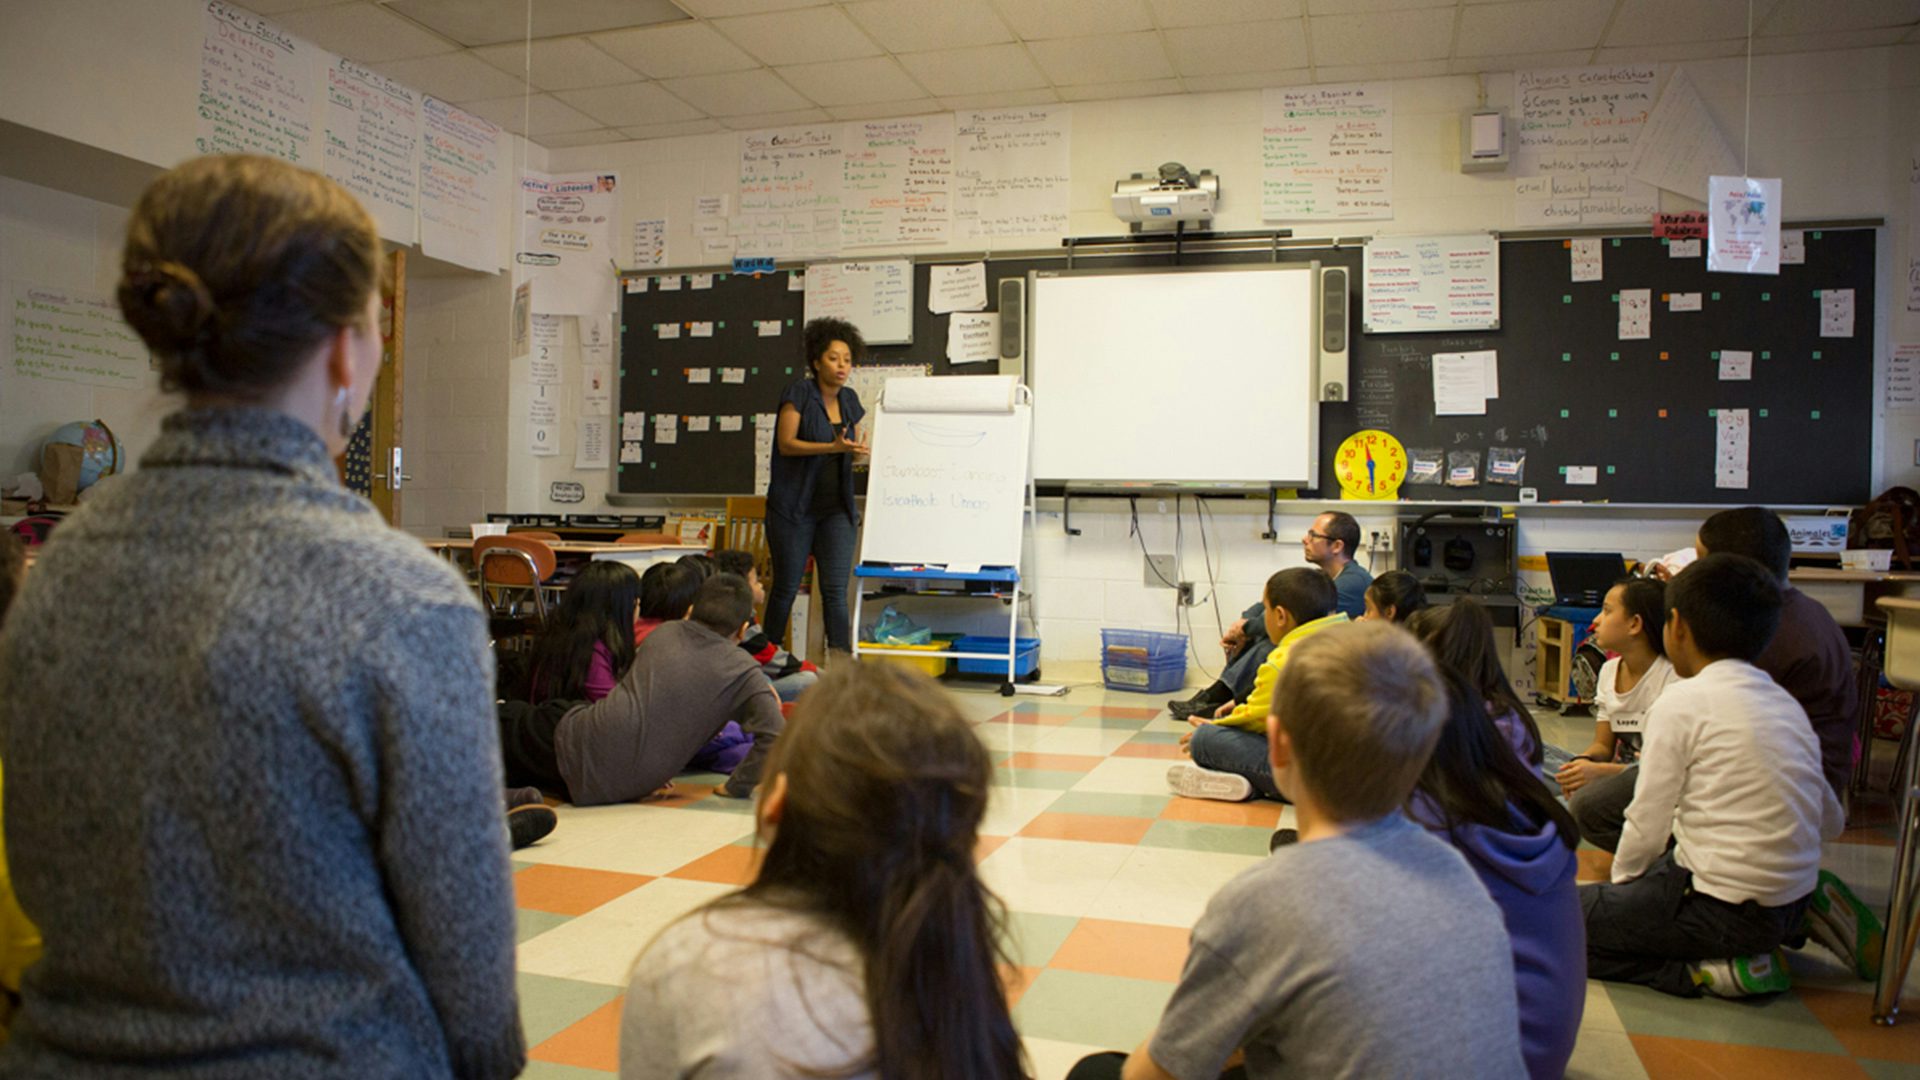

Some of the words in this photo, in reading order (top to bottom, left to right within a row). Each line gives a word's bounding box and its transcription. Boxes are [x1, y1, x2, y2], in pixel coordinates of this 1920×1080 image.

[1624, 92, 1648, 100] una
[522, 180, 549, 190] Active
[556, 184, 594, 193] Listening
[1516, 180, 1546, 194] cruel
[1660, 214, 1696, 224] Muralla
[1664, 225, 1702, 235] Palabras
[735, 258, 756, 267] Word
[540, 348, 548, 360] 2
[540, 386, 546, 397] 1
[537, 430, 546, 442] 0
[1366, 435, 1377, 444] 12
[1354, 440, 1364, 448] 11
[1382, 439, 1387, 448] 1
[1345, 449, 1356, 458] 10
[1390, 448, 1398, 456] 2
[1342, 460, 1348, 469] 9
[1394, 460, 1401, 470] 3
[1346, 472, 1352, 481] 8
[1389, 472, 1396, 481] 4
[1355, 480, 1362, 490] 7
[1367, 482, 1374, 493] 6
[1379, 480, 1386, 490] 5
[1790, 528, 1831, 538] Animales
